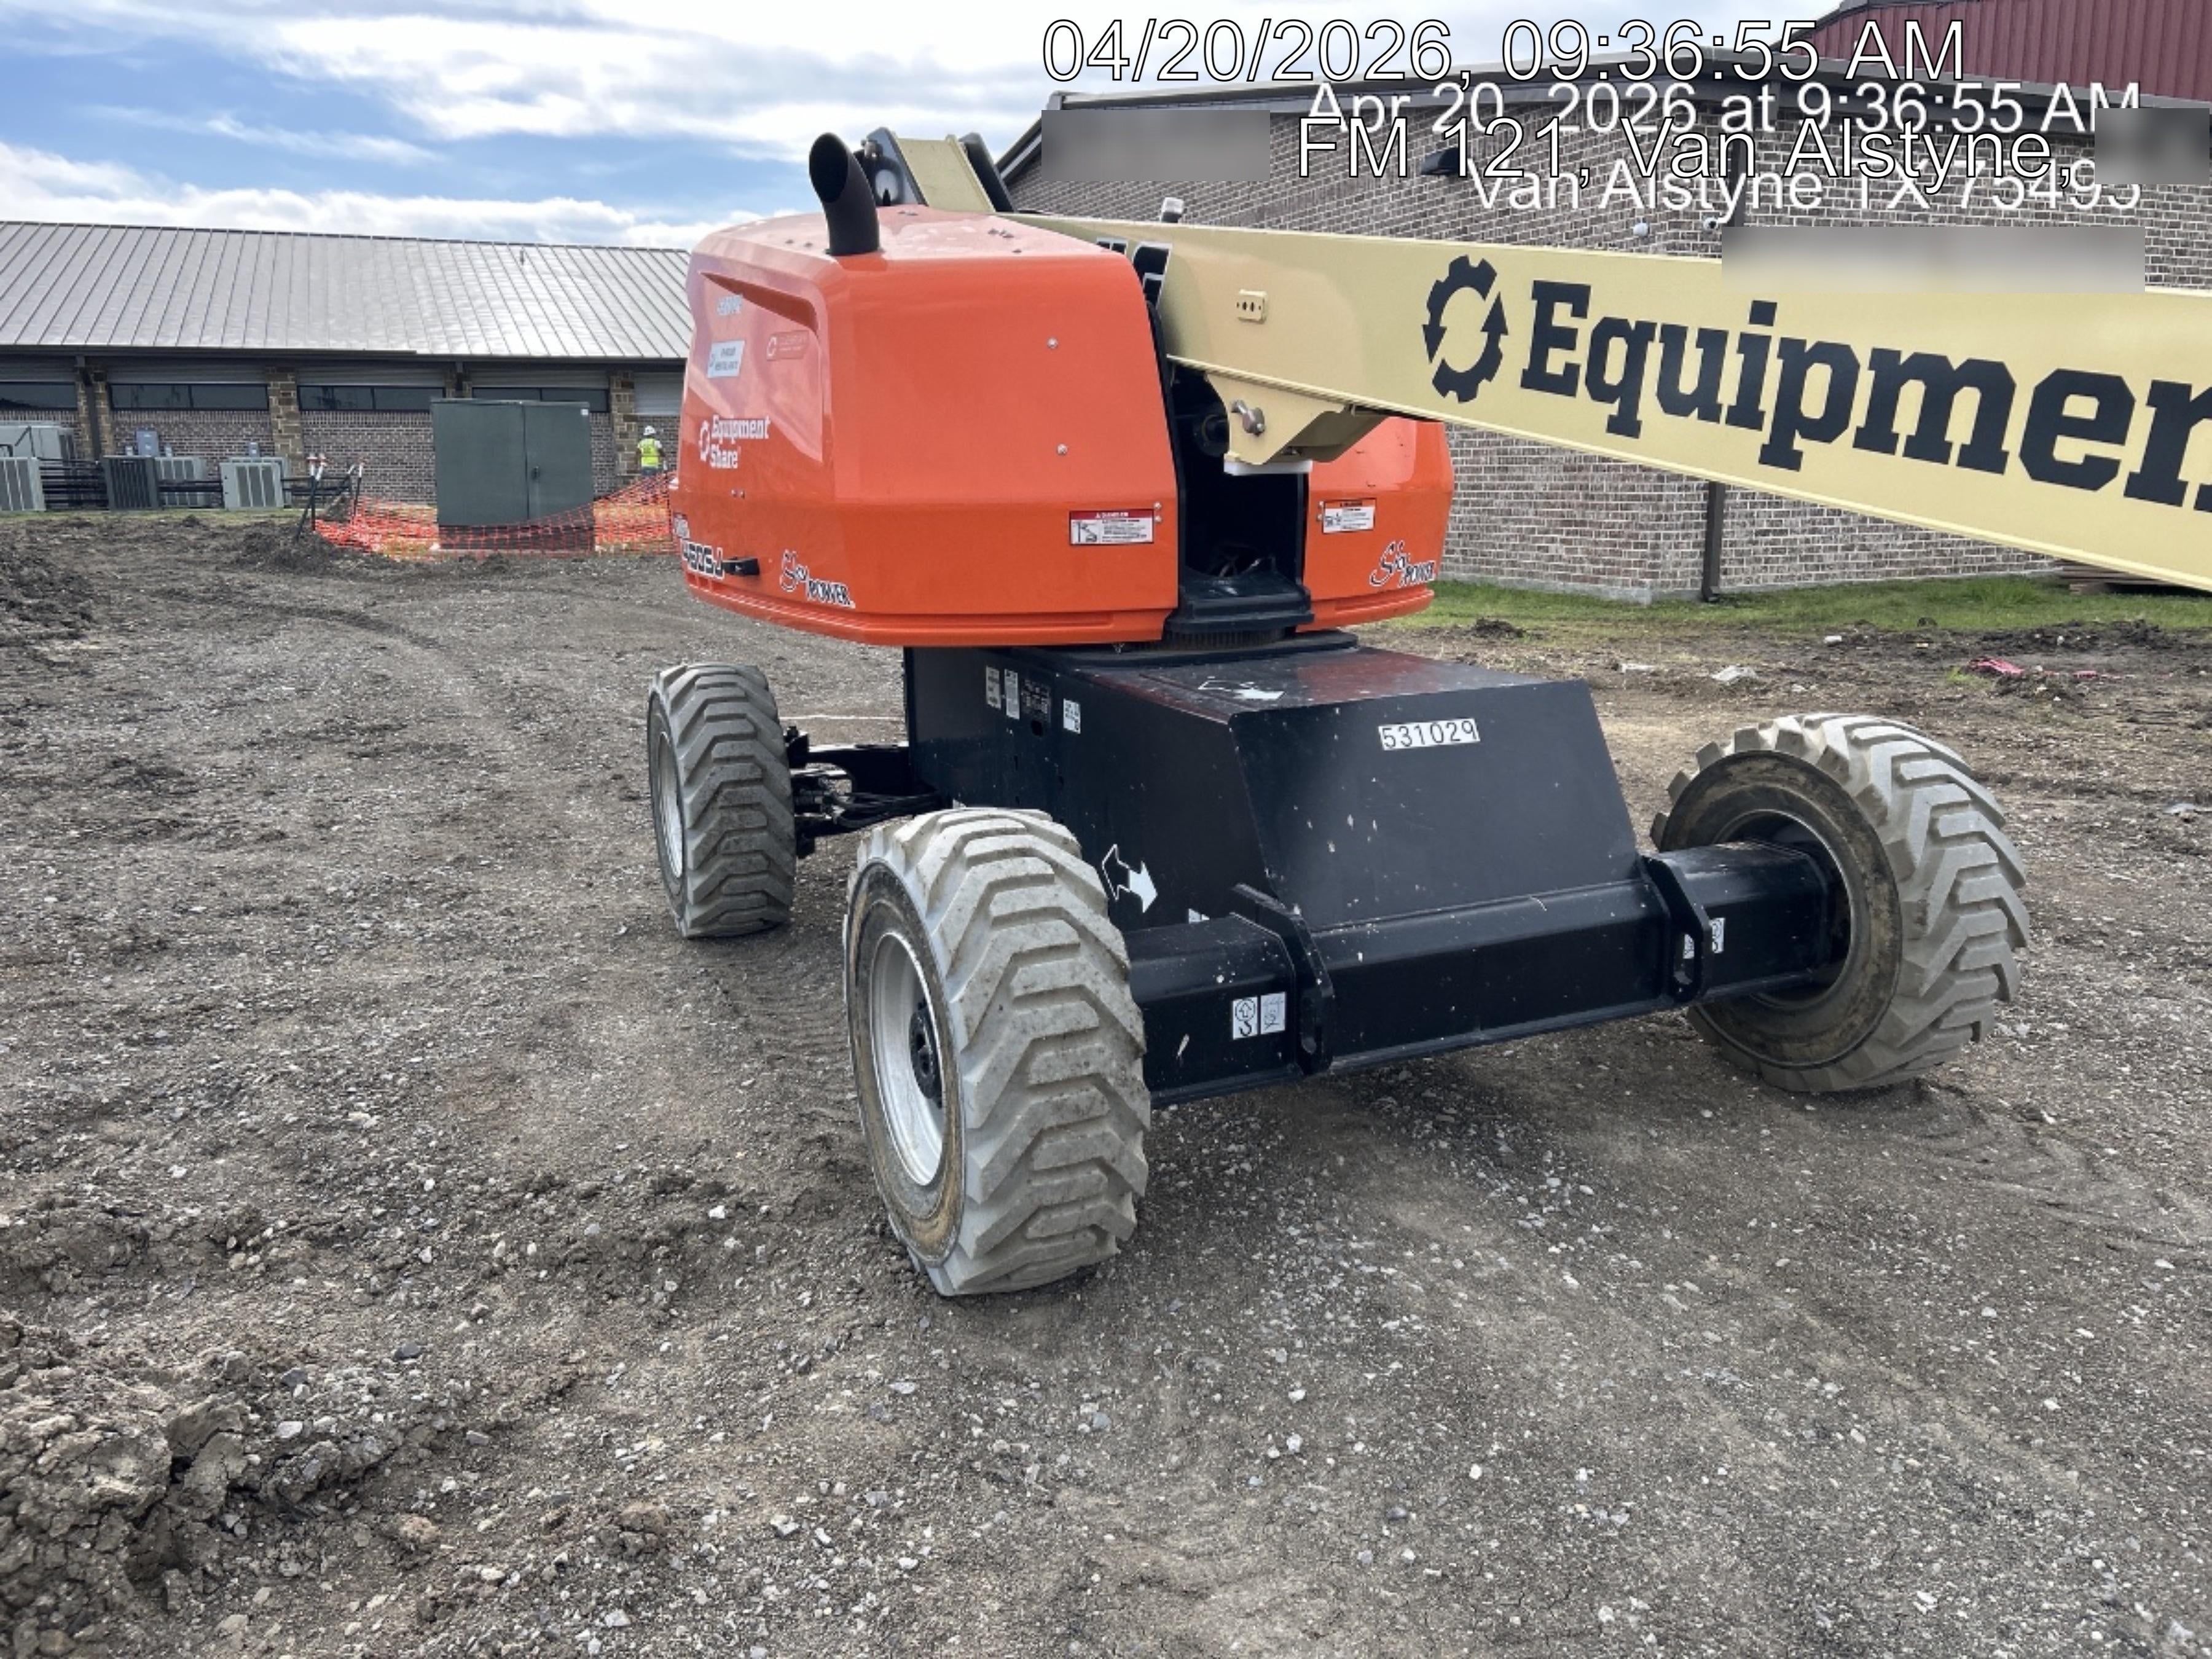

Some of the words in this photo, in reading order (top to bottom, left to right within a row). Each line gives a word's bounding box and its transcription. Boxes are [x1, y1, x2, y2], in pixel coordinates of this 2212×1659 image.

[710, 414, 771, 445] Equipment
[709, 444, 739, 469] Share
[1382, 720, 1478, 749] 531029
